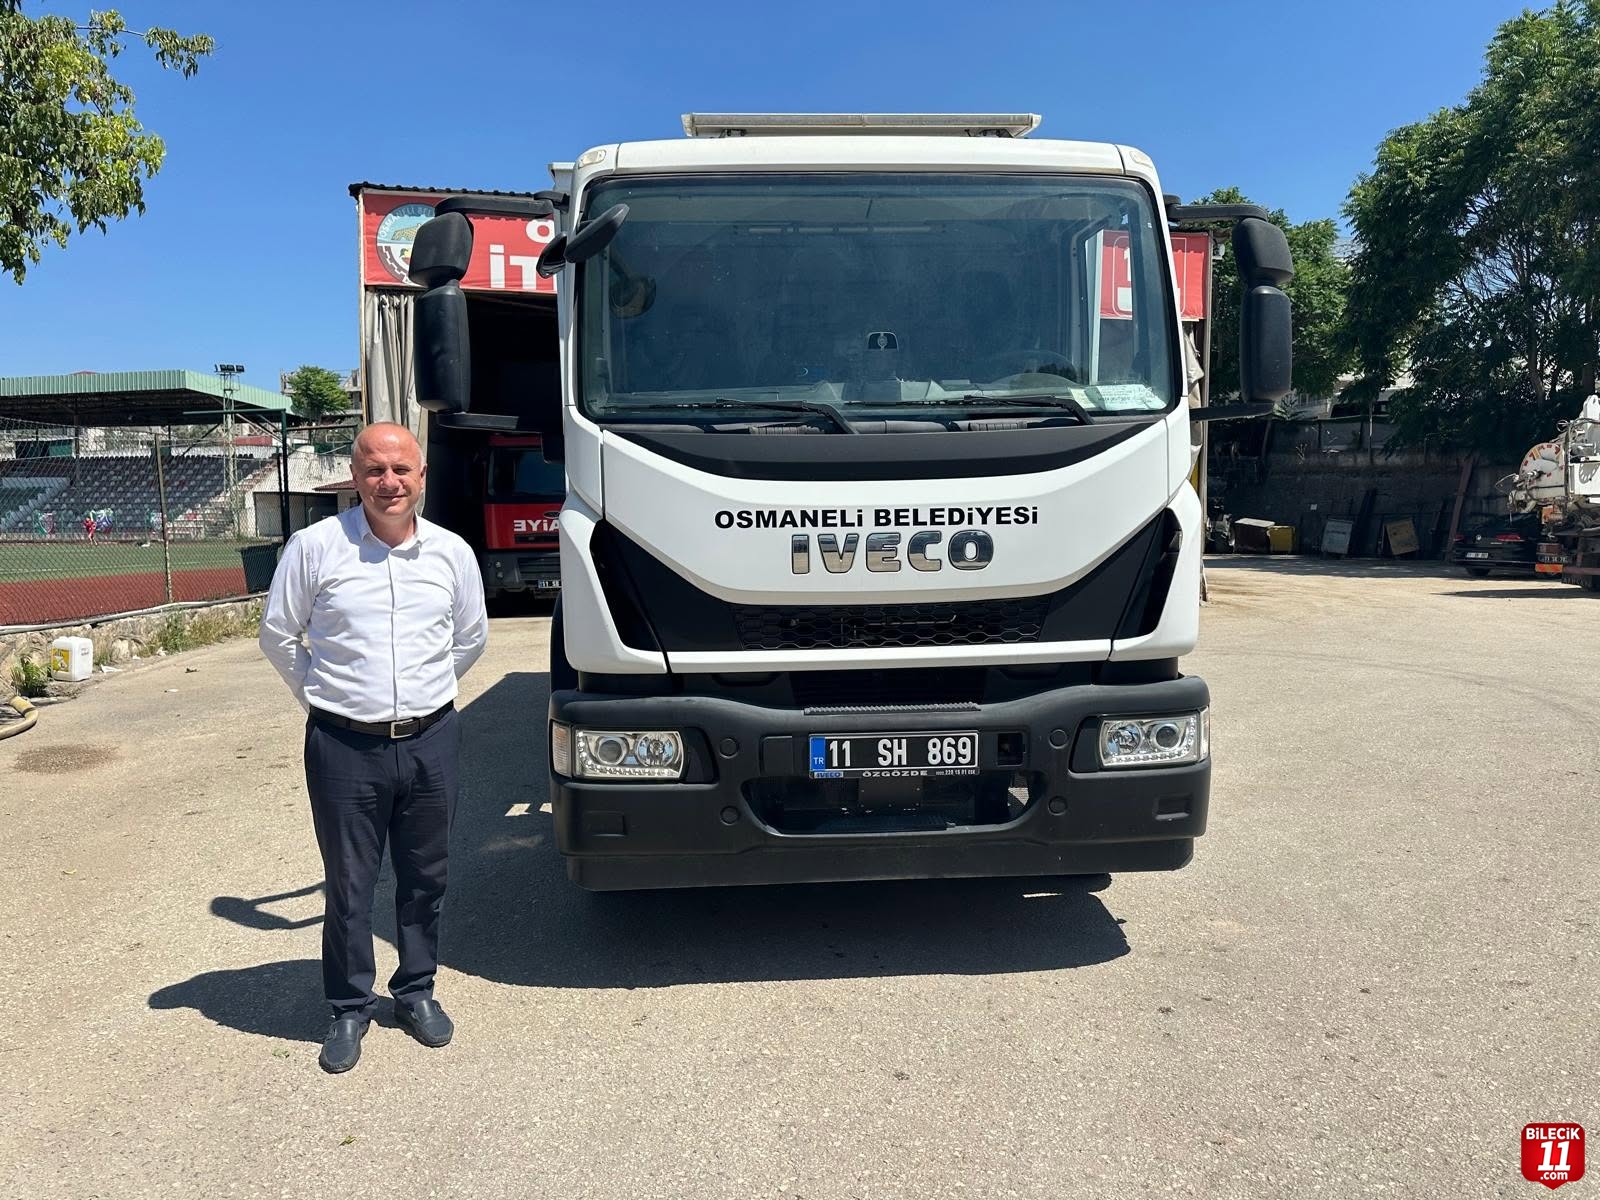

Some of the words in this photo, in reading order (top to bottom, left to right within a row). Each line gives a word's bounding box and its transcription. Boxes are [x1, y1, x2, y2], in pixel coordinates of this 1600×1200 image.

[791, 529, 994, 574] IVECO
[813, 757, 825, 765] TR
[829, 740, 851, 767] 11
[877, 738, 907, 766] SH
[927, 736, 972, 765] 869
